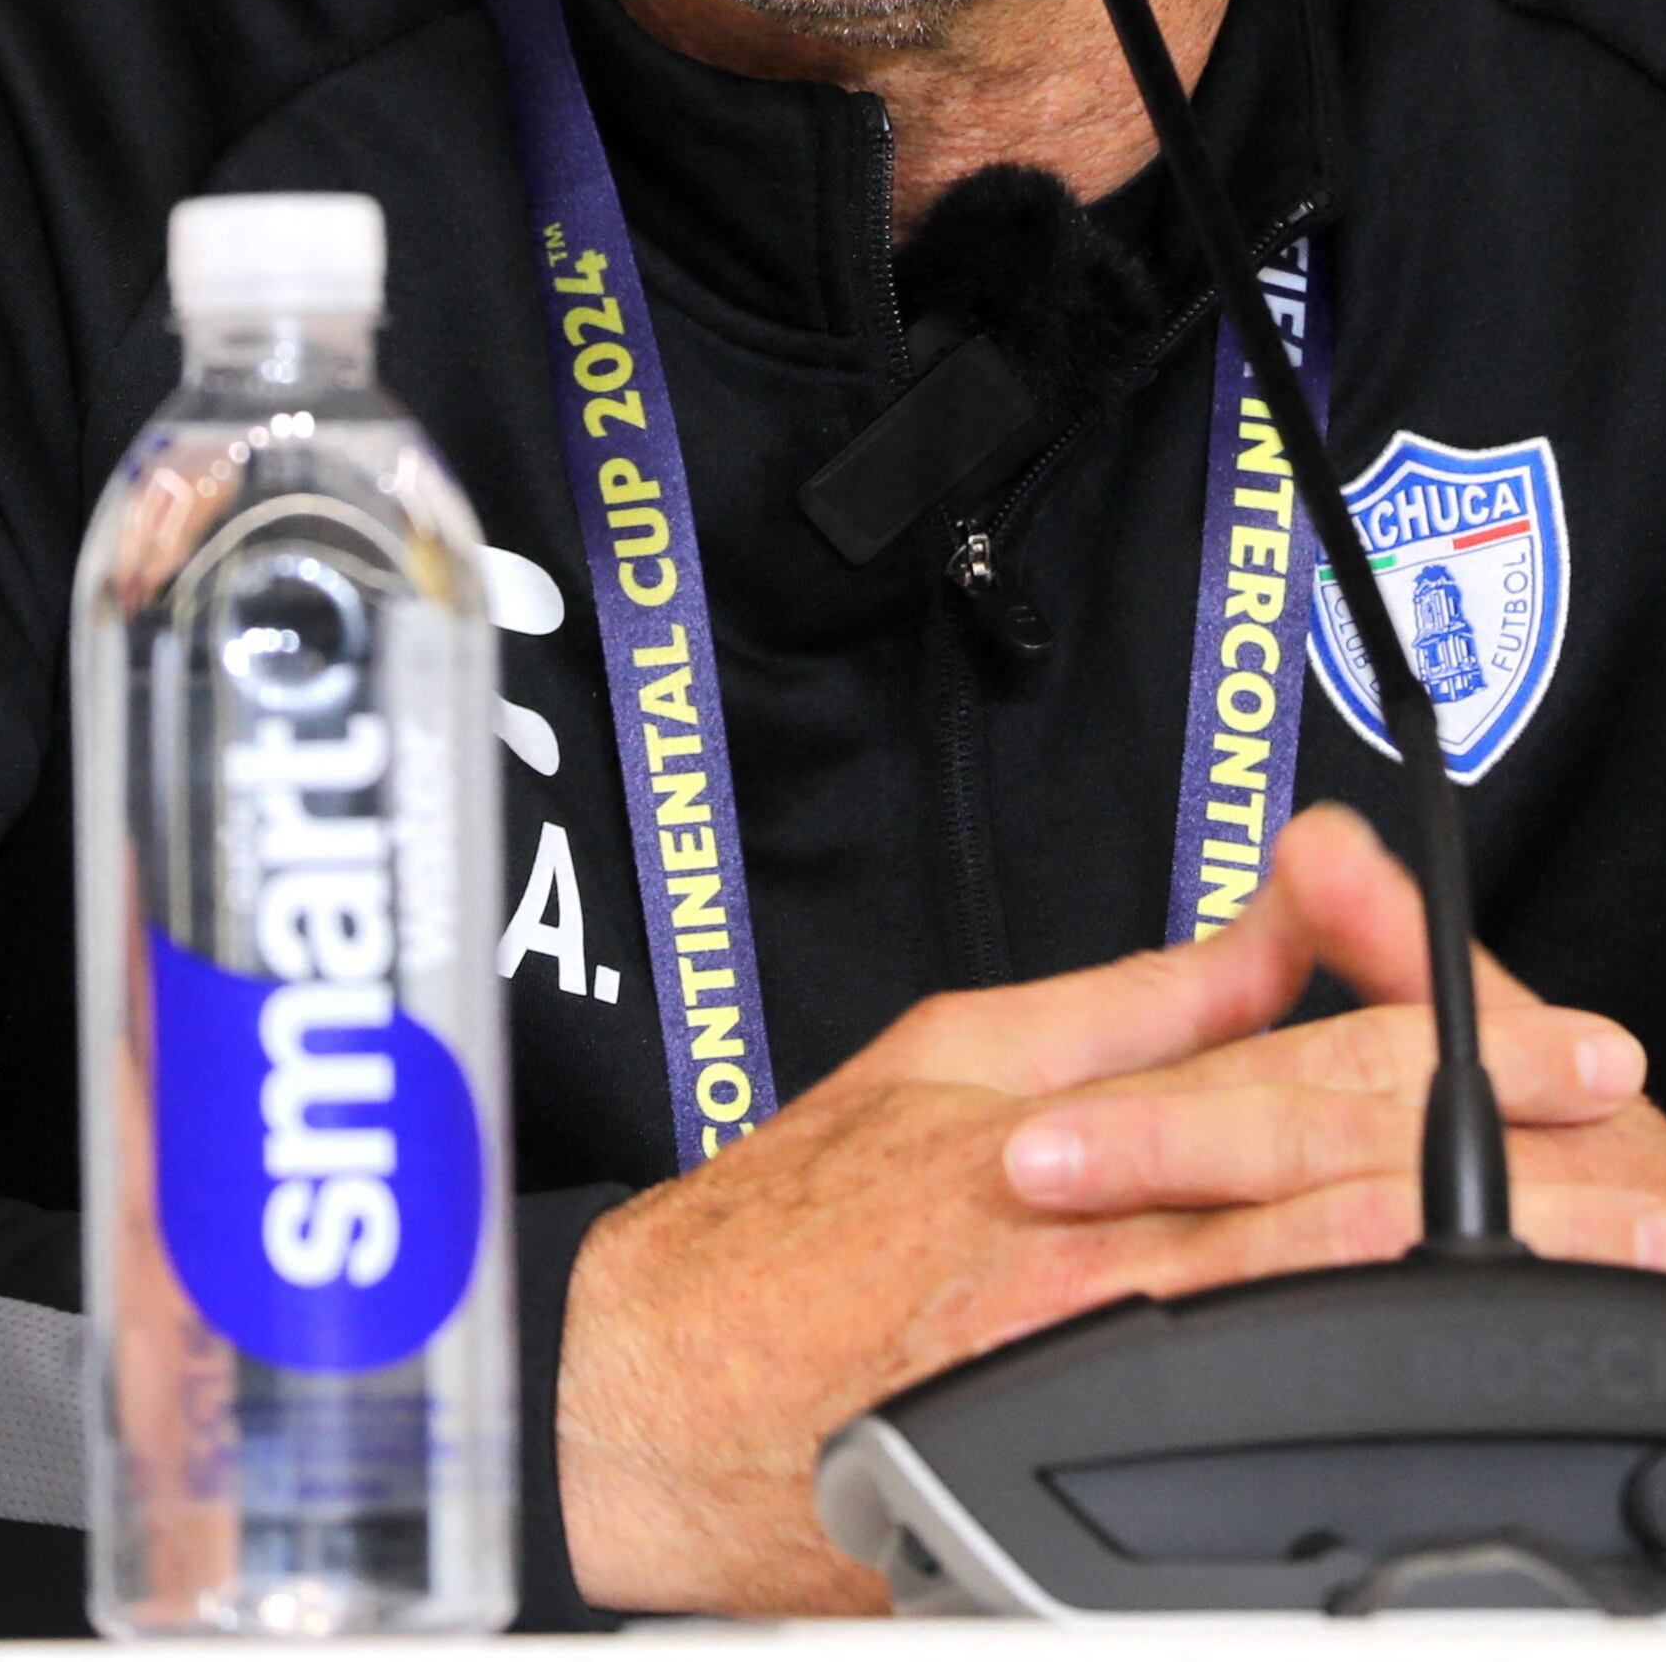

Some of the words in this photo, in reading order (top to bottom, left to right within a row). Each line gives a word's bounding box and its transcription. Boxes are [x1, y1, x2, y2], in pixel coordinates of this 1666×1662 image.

[598, 457, 679, 608] CUP
[1491, 550, 1529, 673] FUTBOL
[221, 711, 402, 1291] smart
